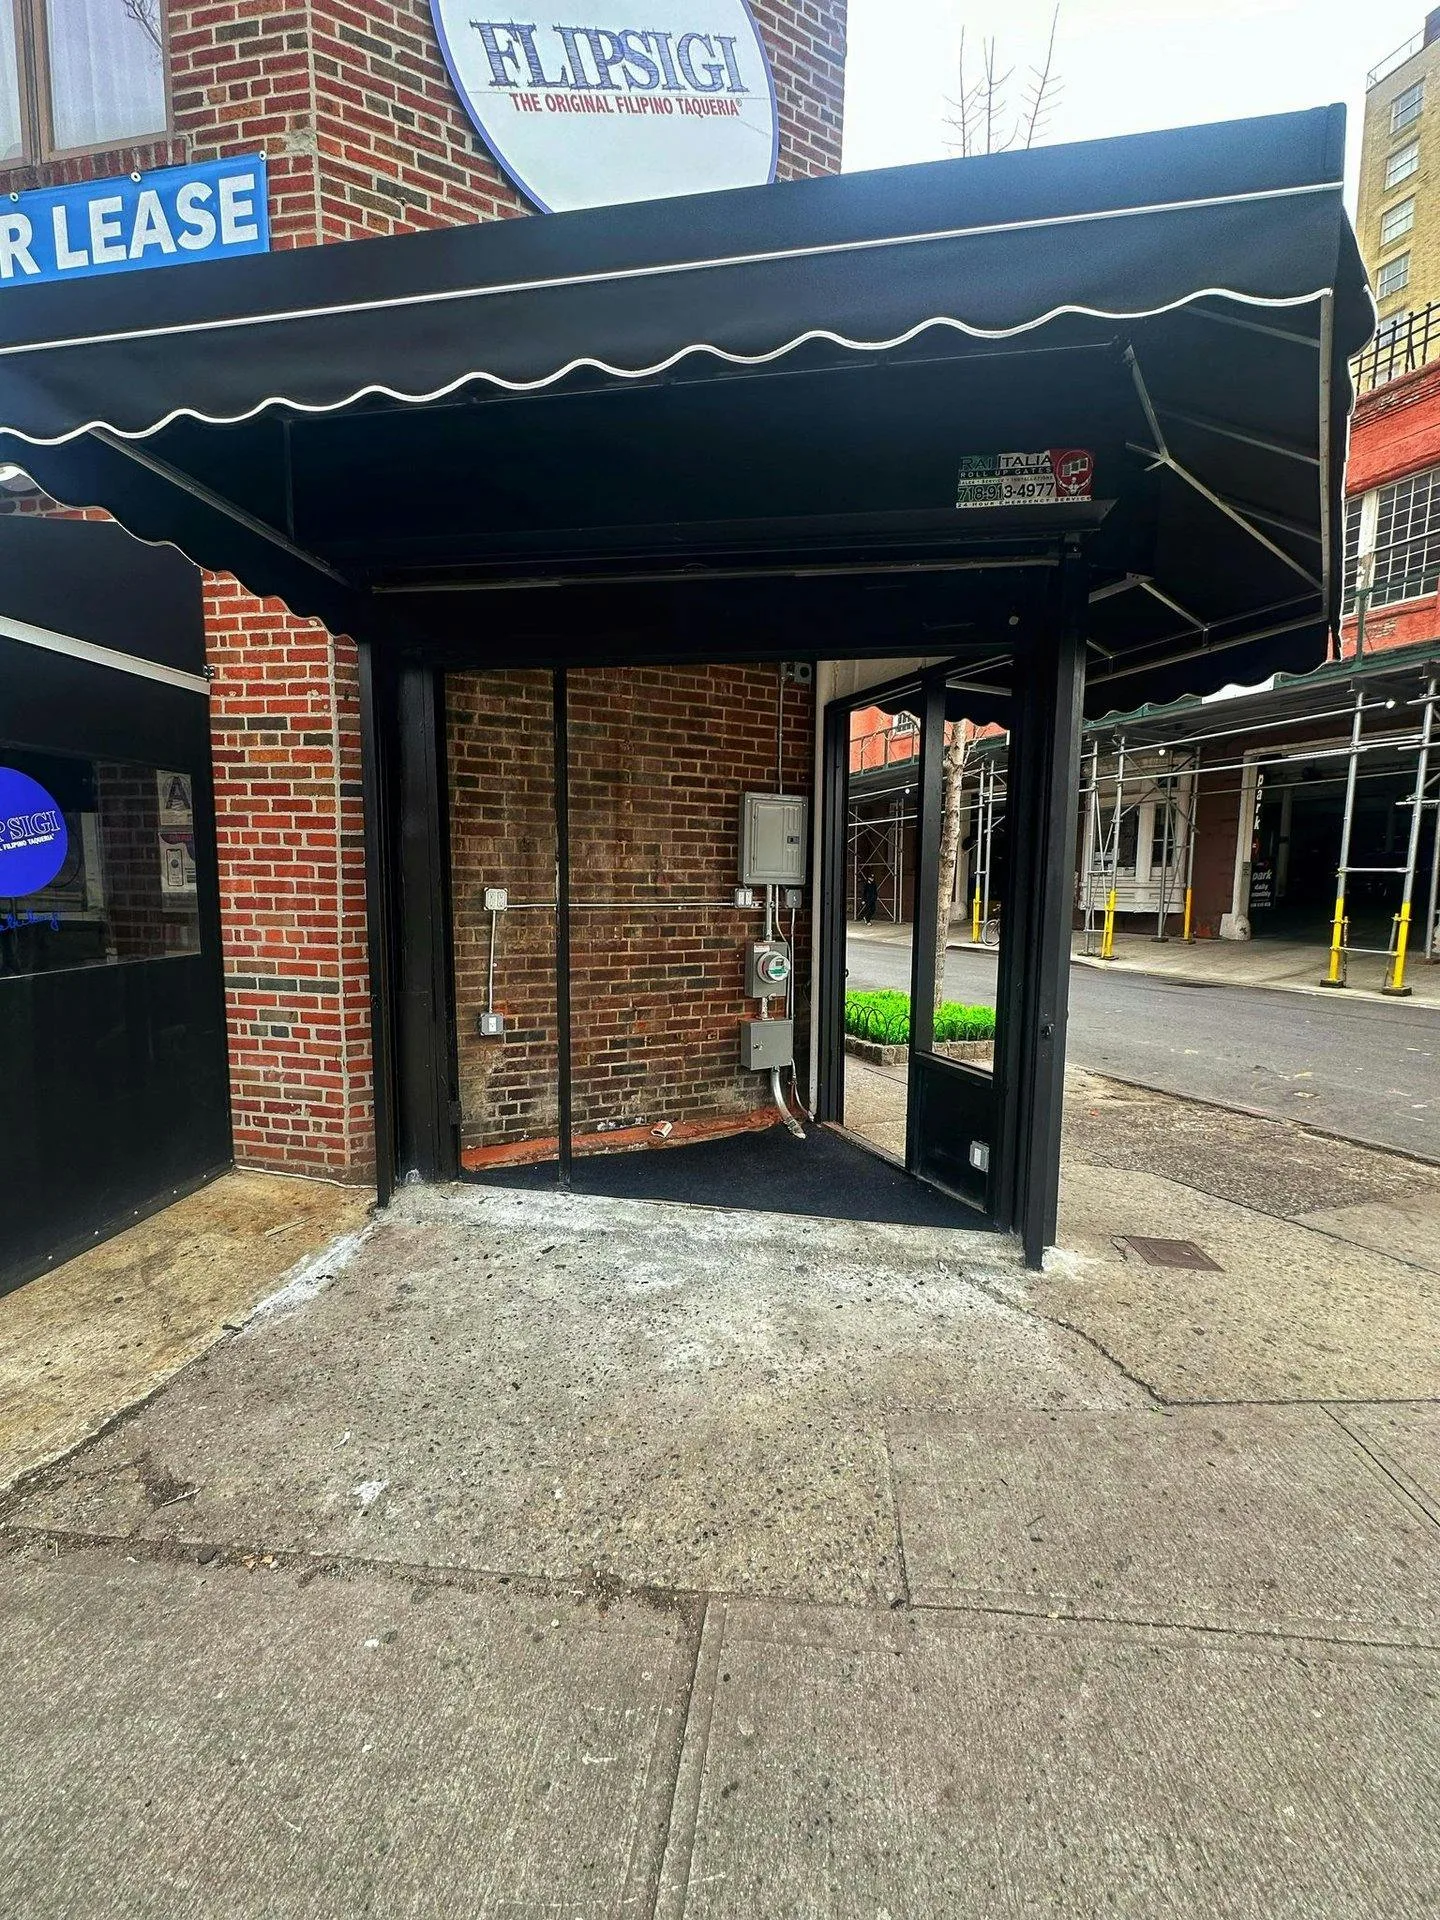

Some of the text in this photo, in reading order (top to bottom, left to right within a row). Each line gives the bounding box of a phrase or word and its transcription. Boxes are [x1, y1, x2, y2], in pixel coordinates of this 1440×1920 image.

[470, 18, 750, 93] FLIPSIGI
[509, 92, 543, 113] THE
[546, 93, 614, 114] ORIGINAL
[618, 95, 674, 115] FILIPINO
[0, 173, 259, 279] R LEASE
[960, 466, 1053, 479] ROLL UP GATES
[998, 454, 1053, 469] ITALIA
[957, 482, 1055, 500] 718-913-4977
[165, 776, 191, 810] A
[1253, 773, 1265, 830] park
